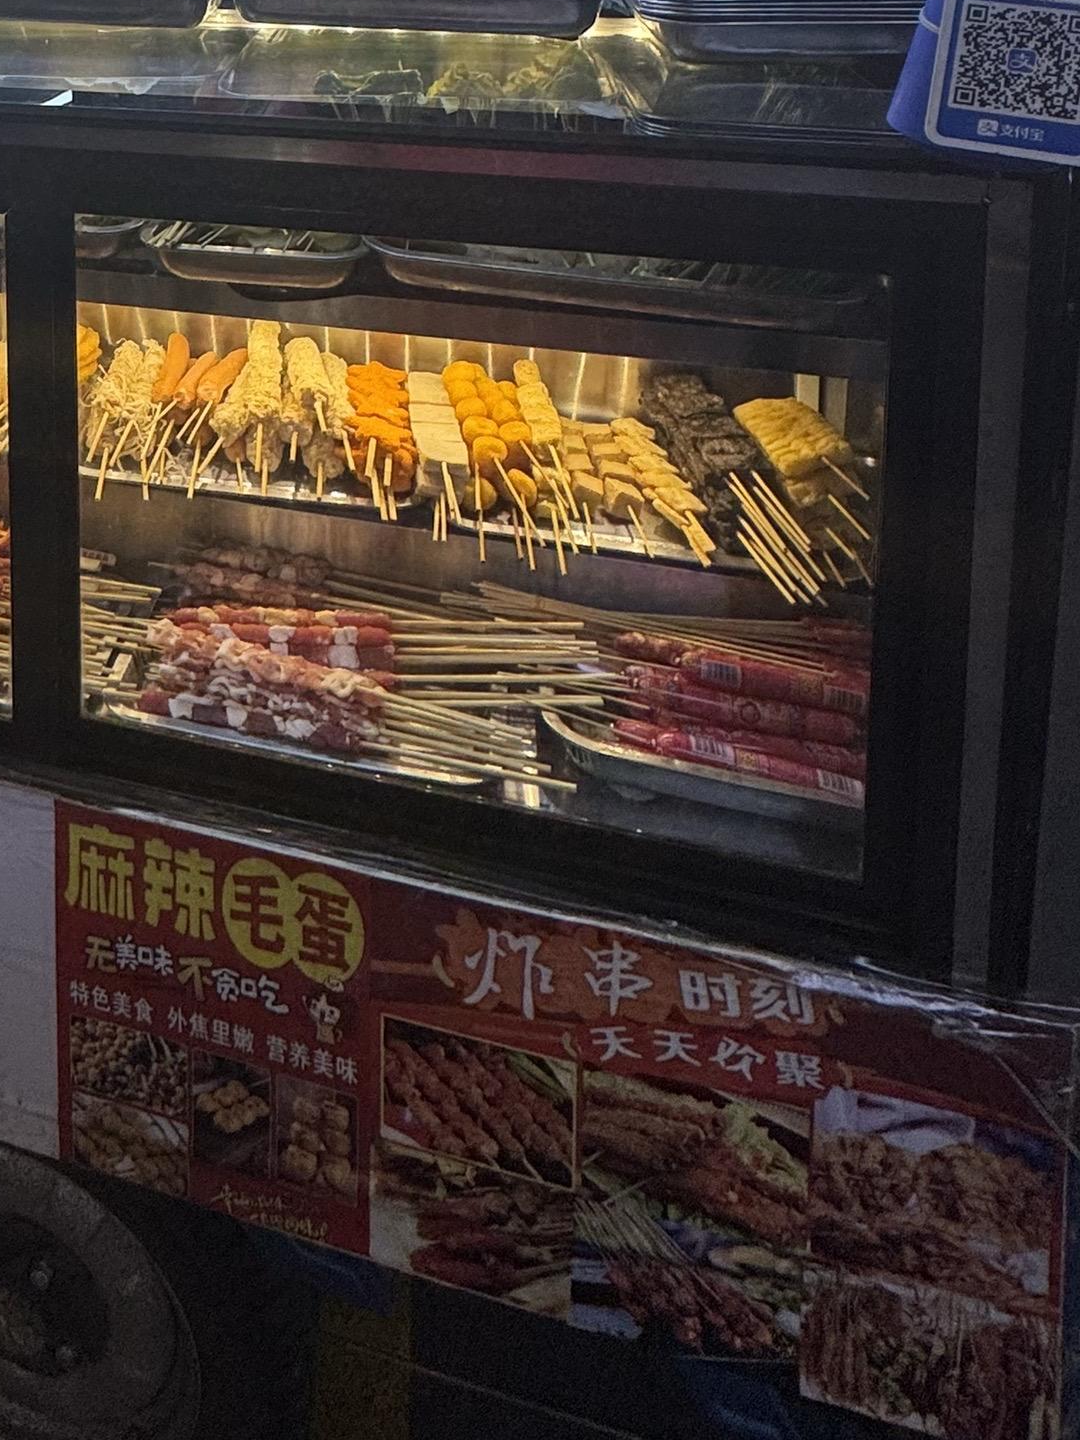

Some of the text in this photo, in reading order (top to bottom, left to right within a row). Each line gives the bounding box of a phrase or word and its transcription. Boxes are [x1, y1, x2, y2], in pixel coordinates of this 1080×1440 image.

[1000, 124, 1044, 141] 支付宝
[64, 823, 360, 975] 麻辣毛蛋
[84, 934, 289, 1015] 无美味不贪吃
[464, 926, 815, 1025] 炸串时刻
[70, 979, 359, 1086] 特色美食 外焦里嫩 营养美味
[591, 1026, 826, 1088] 天天欢聚
